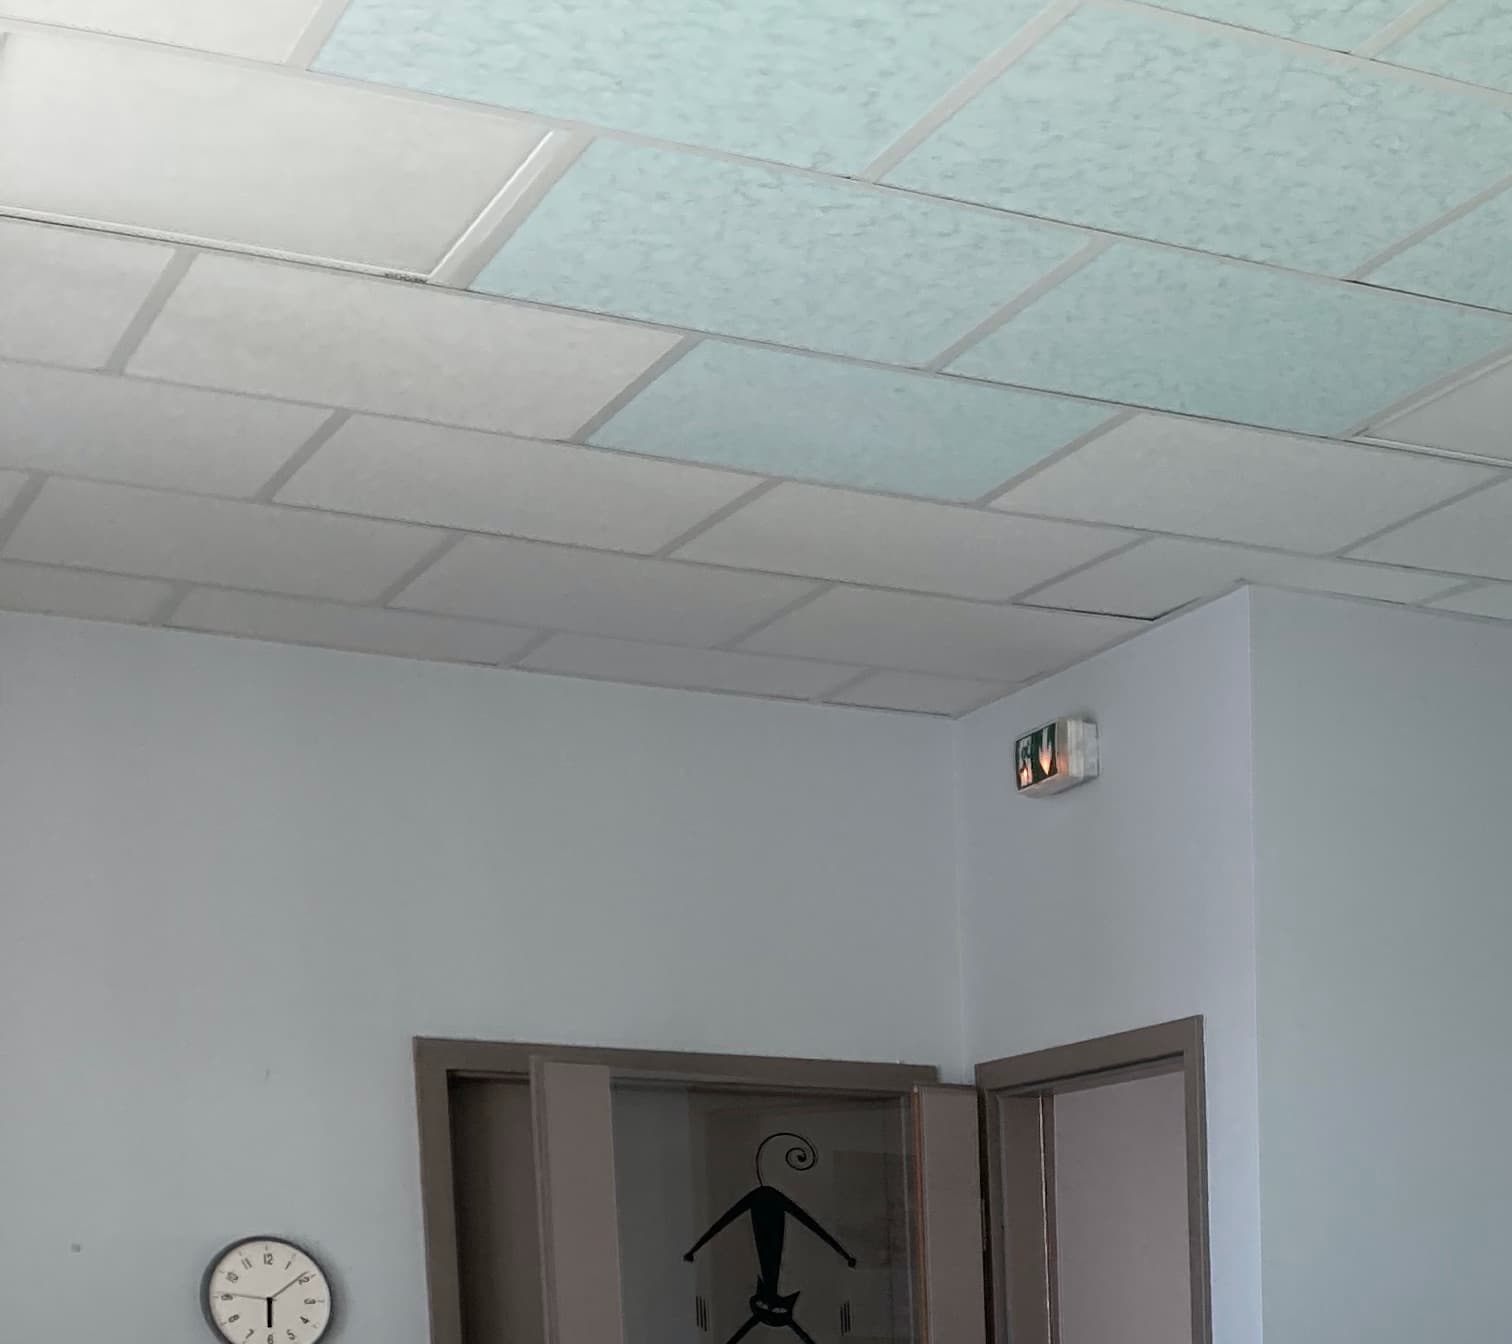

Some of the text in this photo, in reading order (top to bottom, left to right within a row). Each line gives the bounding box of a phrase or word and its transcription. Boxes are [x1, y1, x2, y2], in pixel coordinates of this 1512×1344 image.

[242, 1258, 252, 1270] 11
[264, 1253, 272, 1265] 12
[285, 1261, 291, 1270] 1
[226, 1272, 238, 1284] 10
[298, 1276, 310, 1285] 2
[228, 1314, 240, 1323] 8
[300, 1316, 310, 1324] 4
[246, 1329, 254, 1339] 7
[287, 1329, 295, 1340] 5
